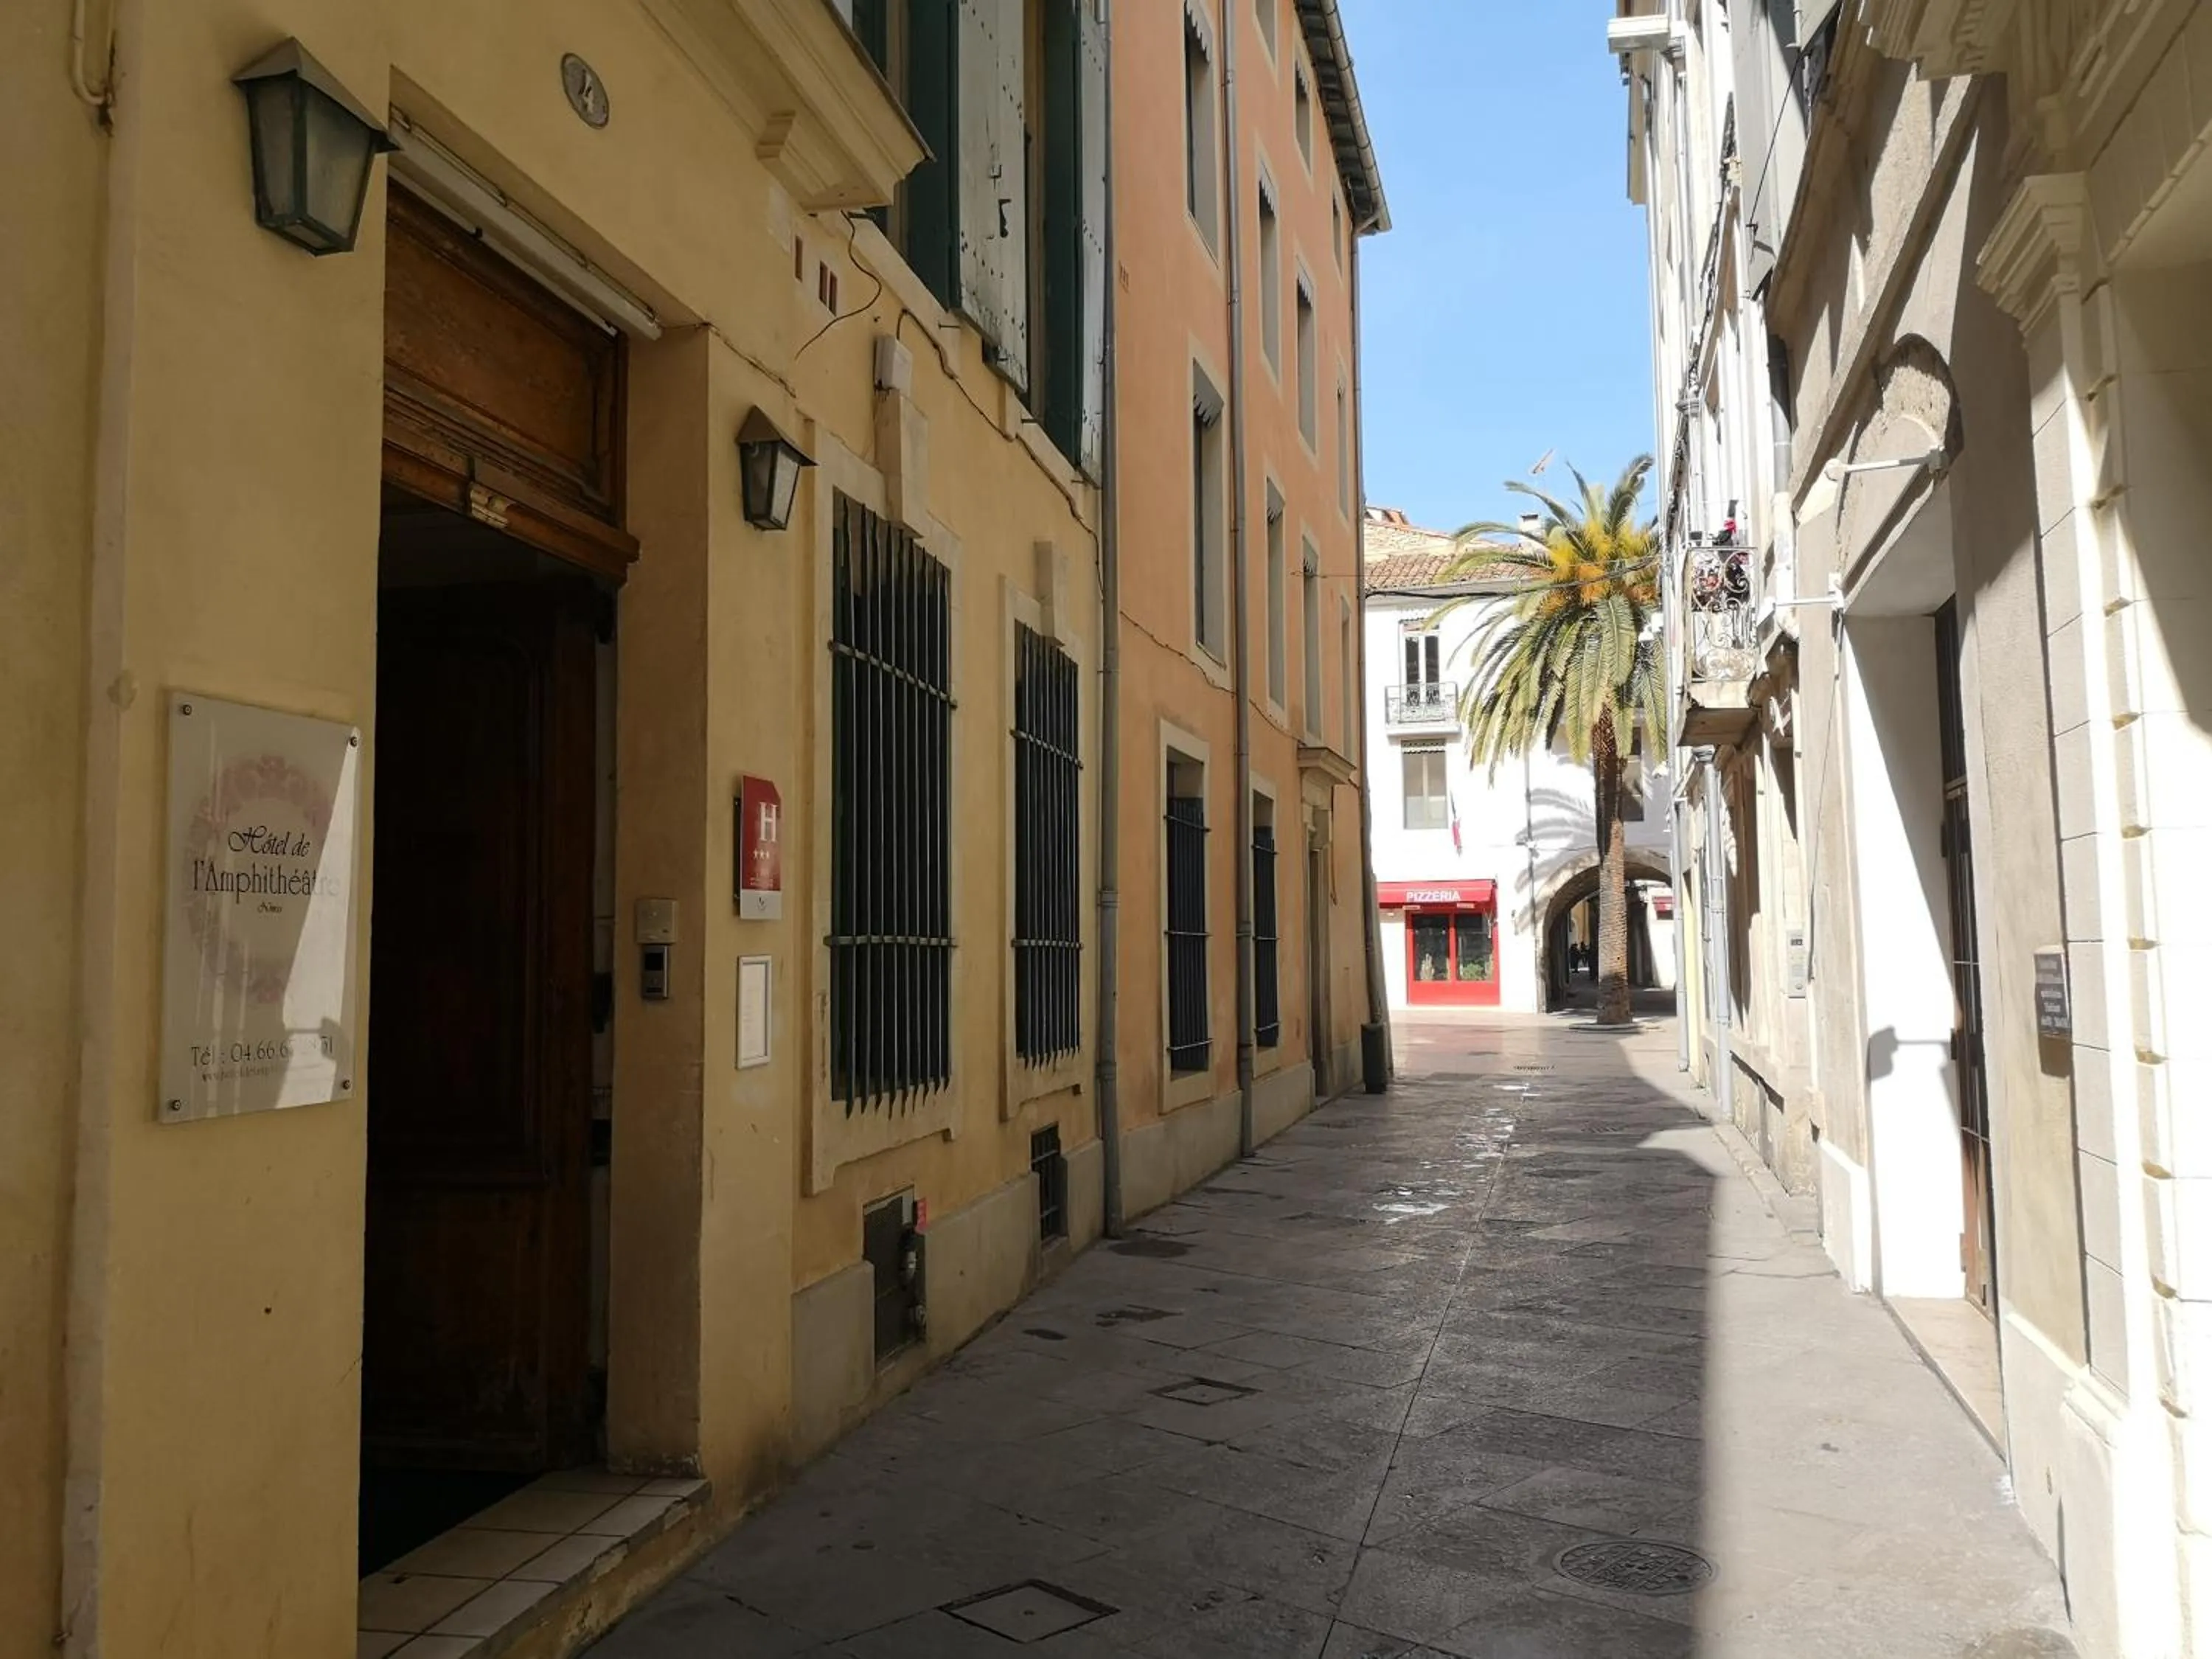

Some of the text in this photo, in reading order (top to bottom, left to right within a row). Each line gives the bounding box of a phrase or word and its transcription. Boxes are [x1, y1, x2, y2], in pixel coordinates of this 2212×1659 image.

[759, 801, 779, 842] H
[227, 824, 311, 858] Hôtel de
[1405, 890, 1460, 903] PIZZERIA
